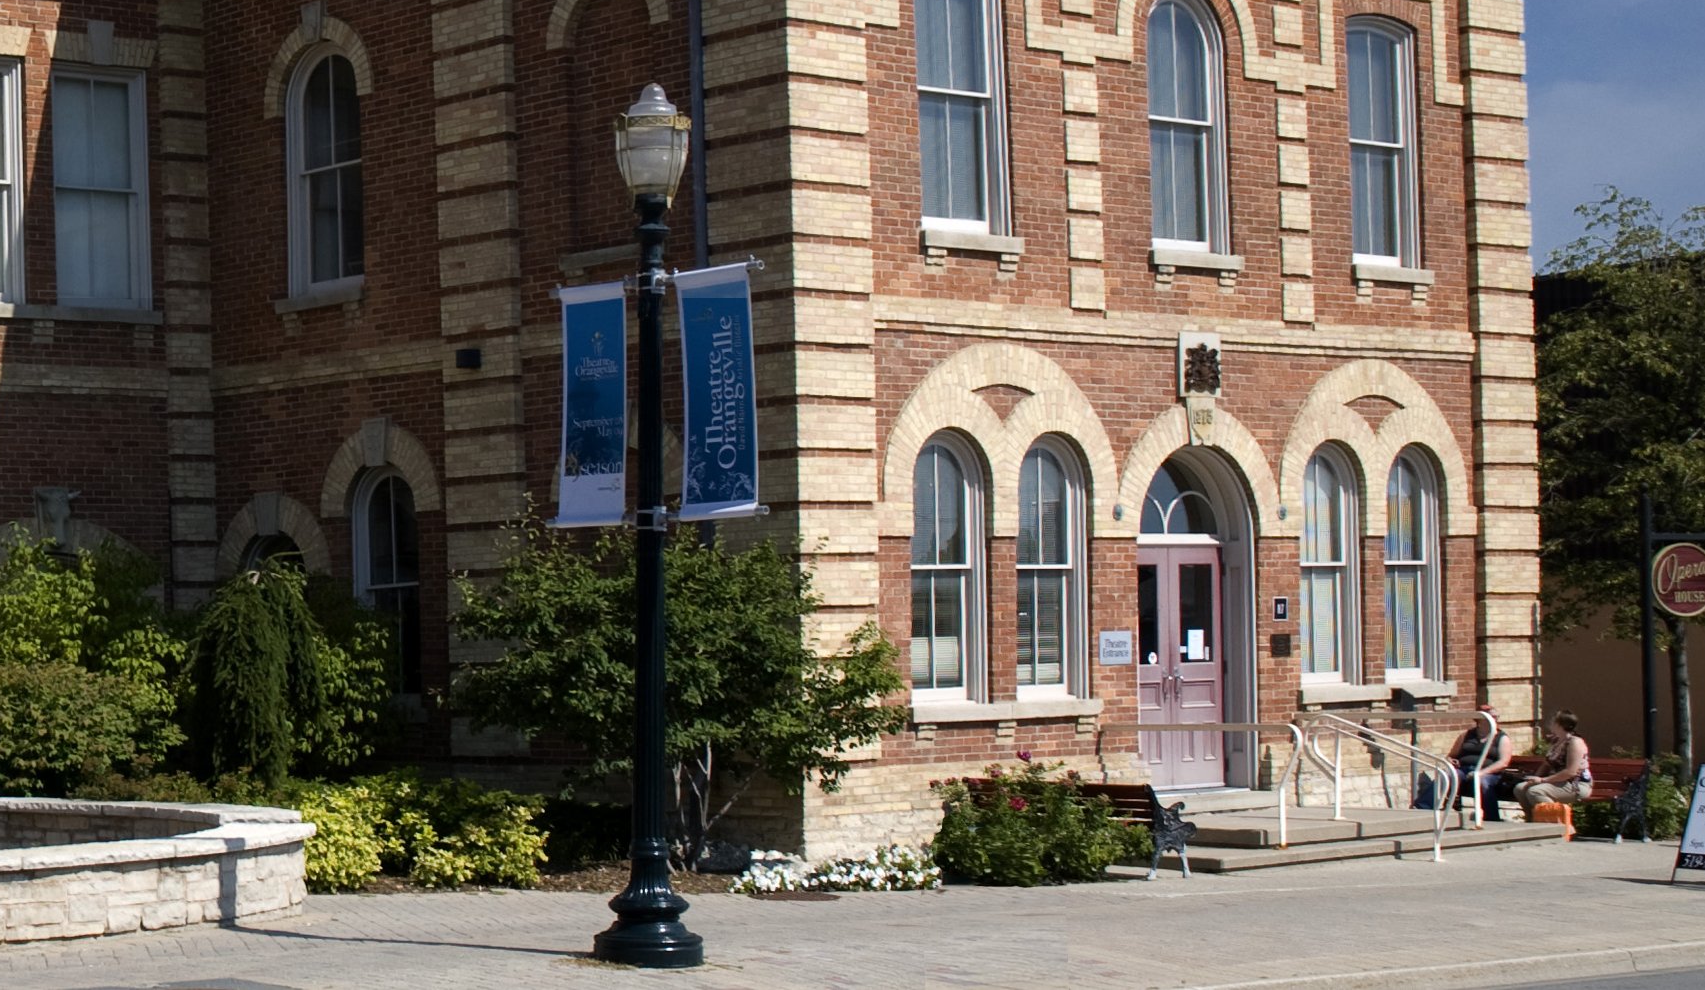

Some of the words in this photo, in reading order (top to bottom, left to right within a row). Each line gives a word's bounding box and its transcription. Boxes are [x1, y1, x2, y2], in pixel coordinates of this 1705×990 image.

[575, 360, 618, 377] Orangeville
[580, 357, 610, 367] Theatre
[717, 315, 745, 469] Orangeville
[705, 351, 723, 453] Theatre
[573, 416, 613, 431] September
[737, 426, 746, 450] David
[579, 461, 623, 476] season
[1658, 554, 1705, 594] Opera
[1674, 591, 1705, 603] HOUSE
[1104, 638, 1128, 648] Theatre
[1103, 647, 1129, 658] Entrance
